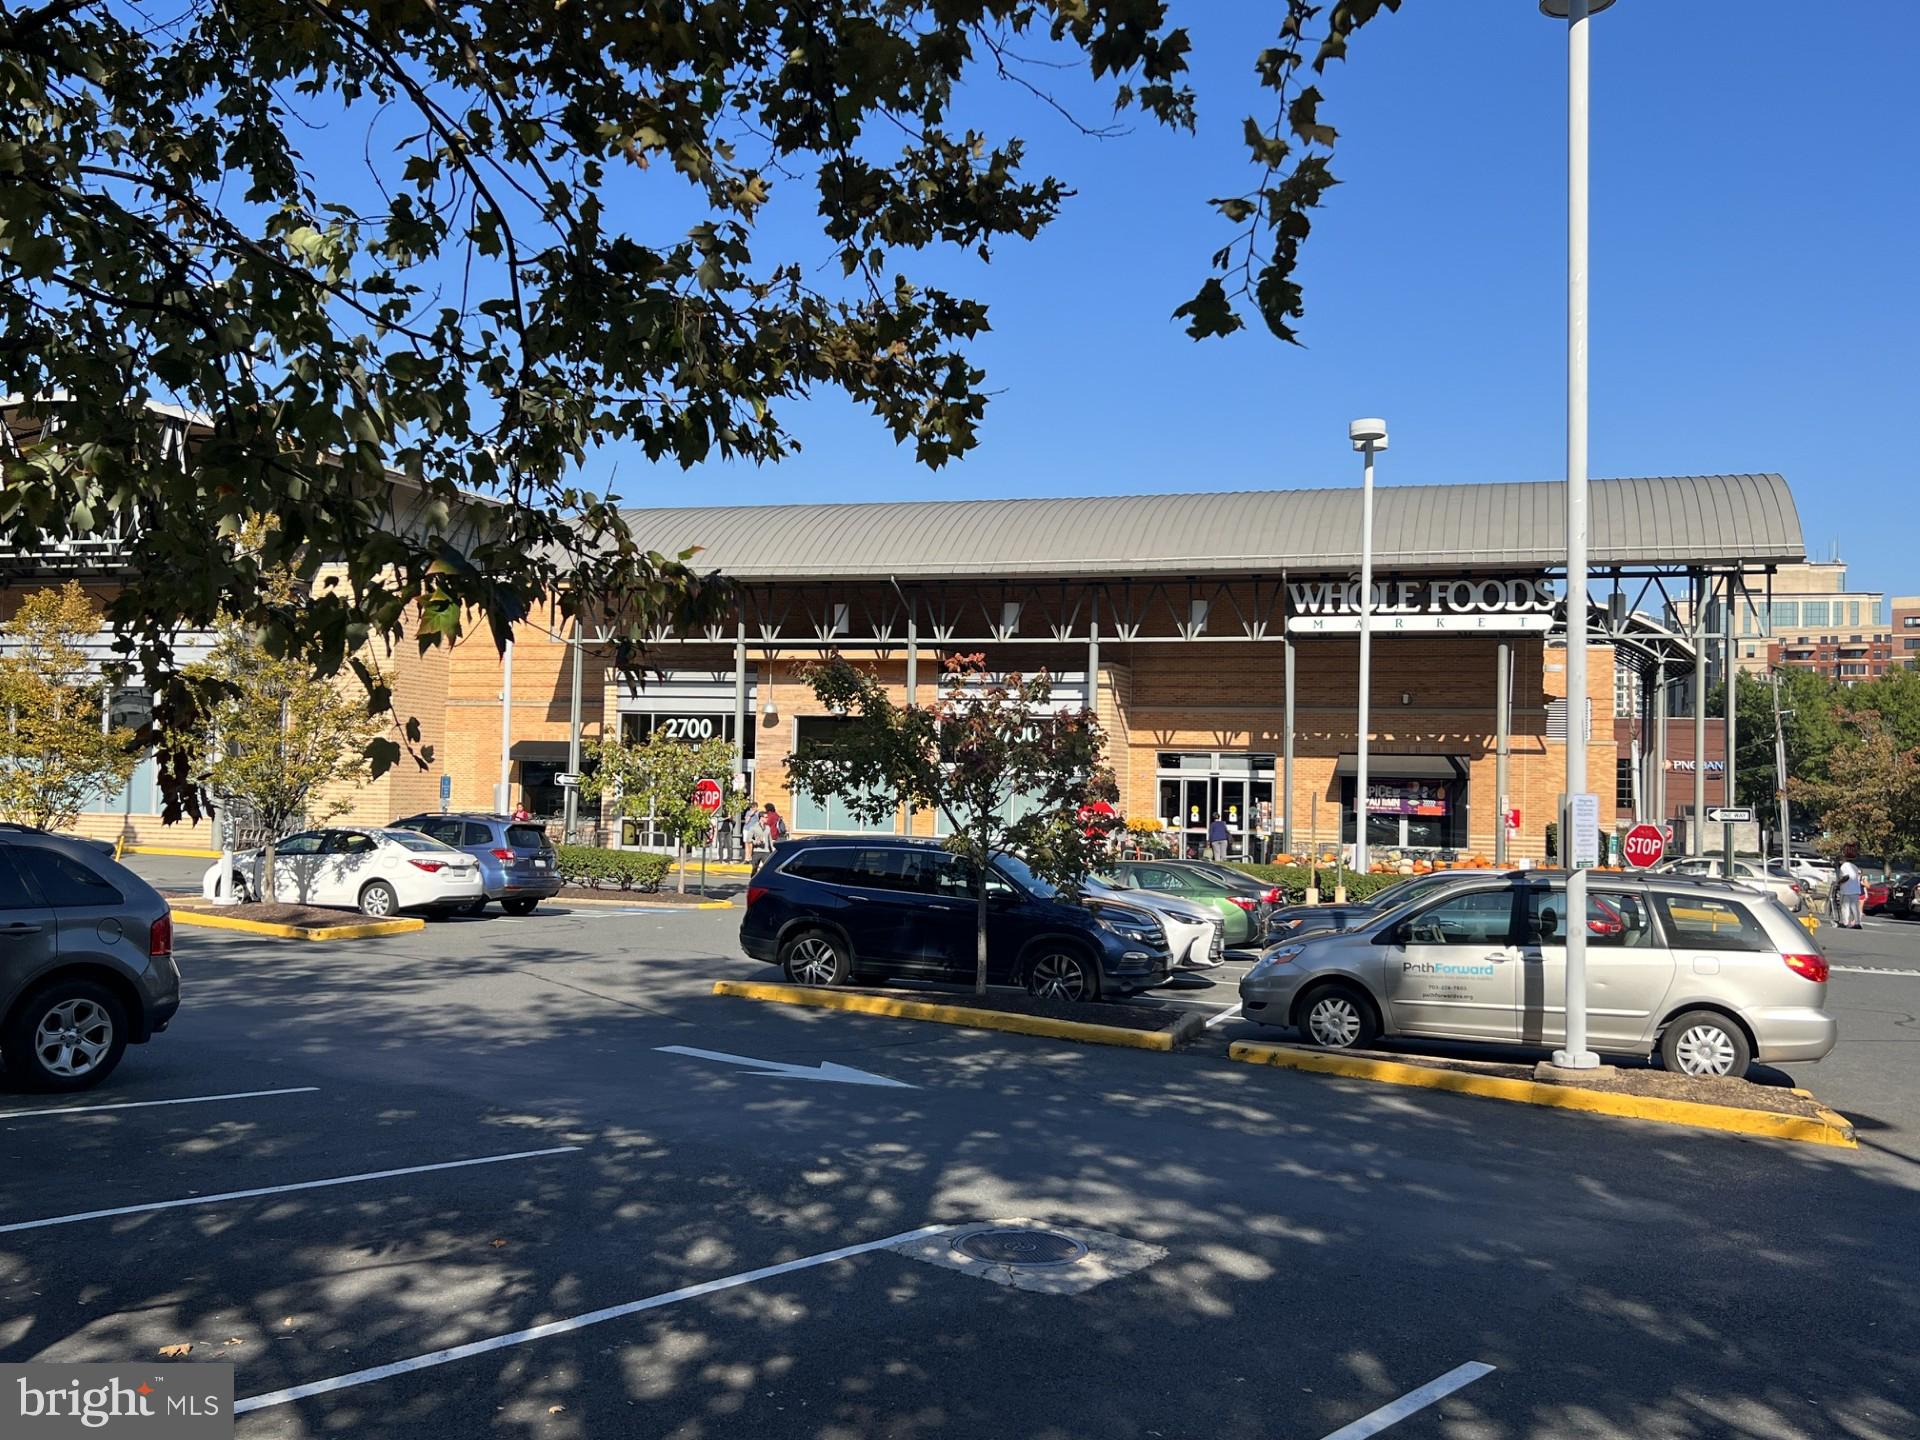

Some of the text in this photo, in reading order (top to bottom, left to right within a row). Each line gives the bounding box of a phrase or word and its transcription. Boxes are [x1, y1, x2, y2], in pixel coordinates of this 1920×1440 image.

[1287, 579, 1557, 614] WHOLE FOODS
[1313, 617, 1528, 629] MARKET
[665, 718, 713, 739] 2700
[1703, 760, 1725, 771] BAN
[1626, 837, 1662, 856] STOP
[1403, 962, 1494, 976] PathForward
